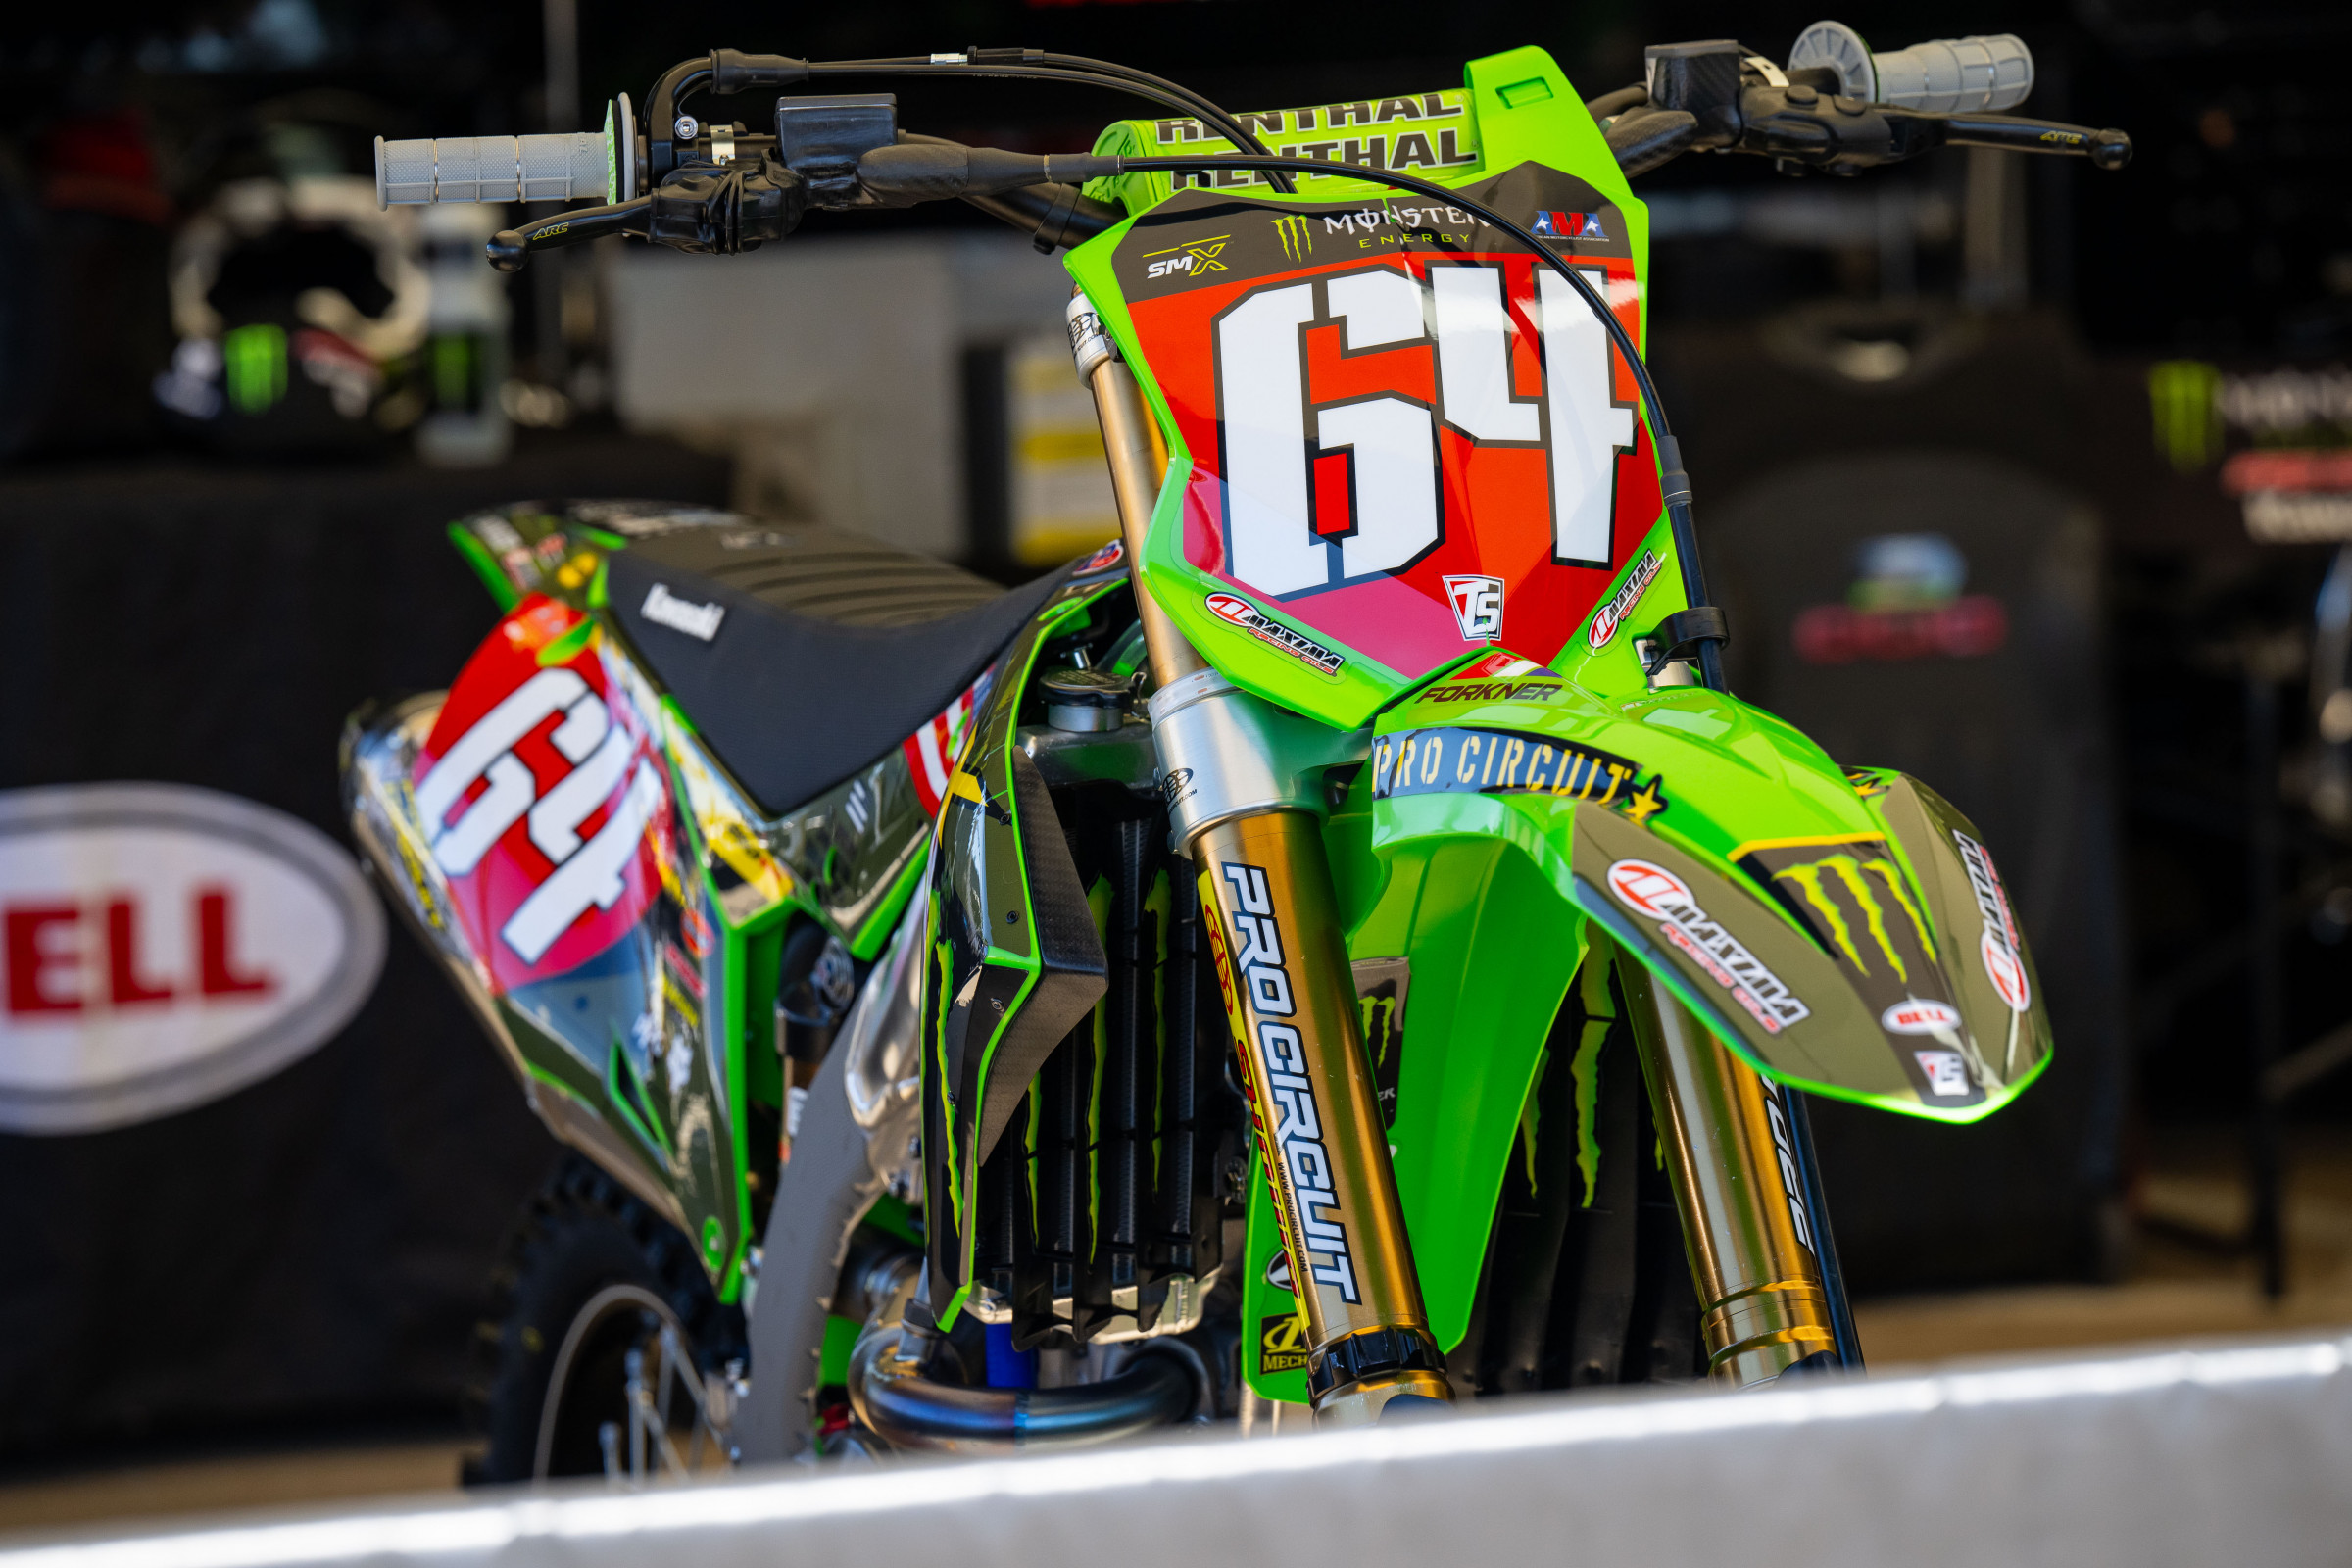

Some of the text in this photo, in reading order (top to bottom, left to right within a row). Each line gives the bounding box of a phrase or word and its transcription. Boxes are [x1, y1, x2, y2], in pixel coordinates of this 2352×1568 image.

[533, 222, 569, 240] ARC
[1359, 233, 1470, 249] ENERGY
[1531, 210, 1608, 237] AMA
[1147, 242, 1229, 279] SMX
[1213, 263, 1637, 601] 64
[1414, 682, 1563, 704] FORKNER
[1372, 735, 1633, 806] PRO CIRCUIT
[412, 667, 664, 965] 64
[1221, 861, 1362, 1306] PRO CIRCUIT
